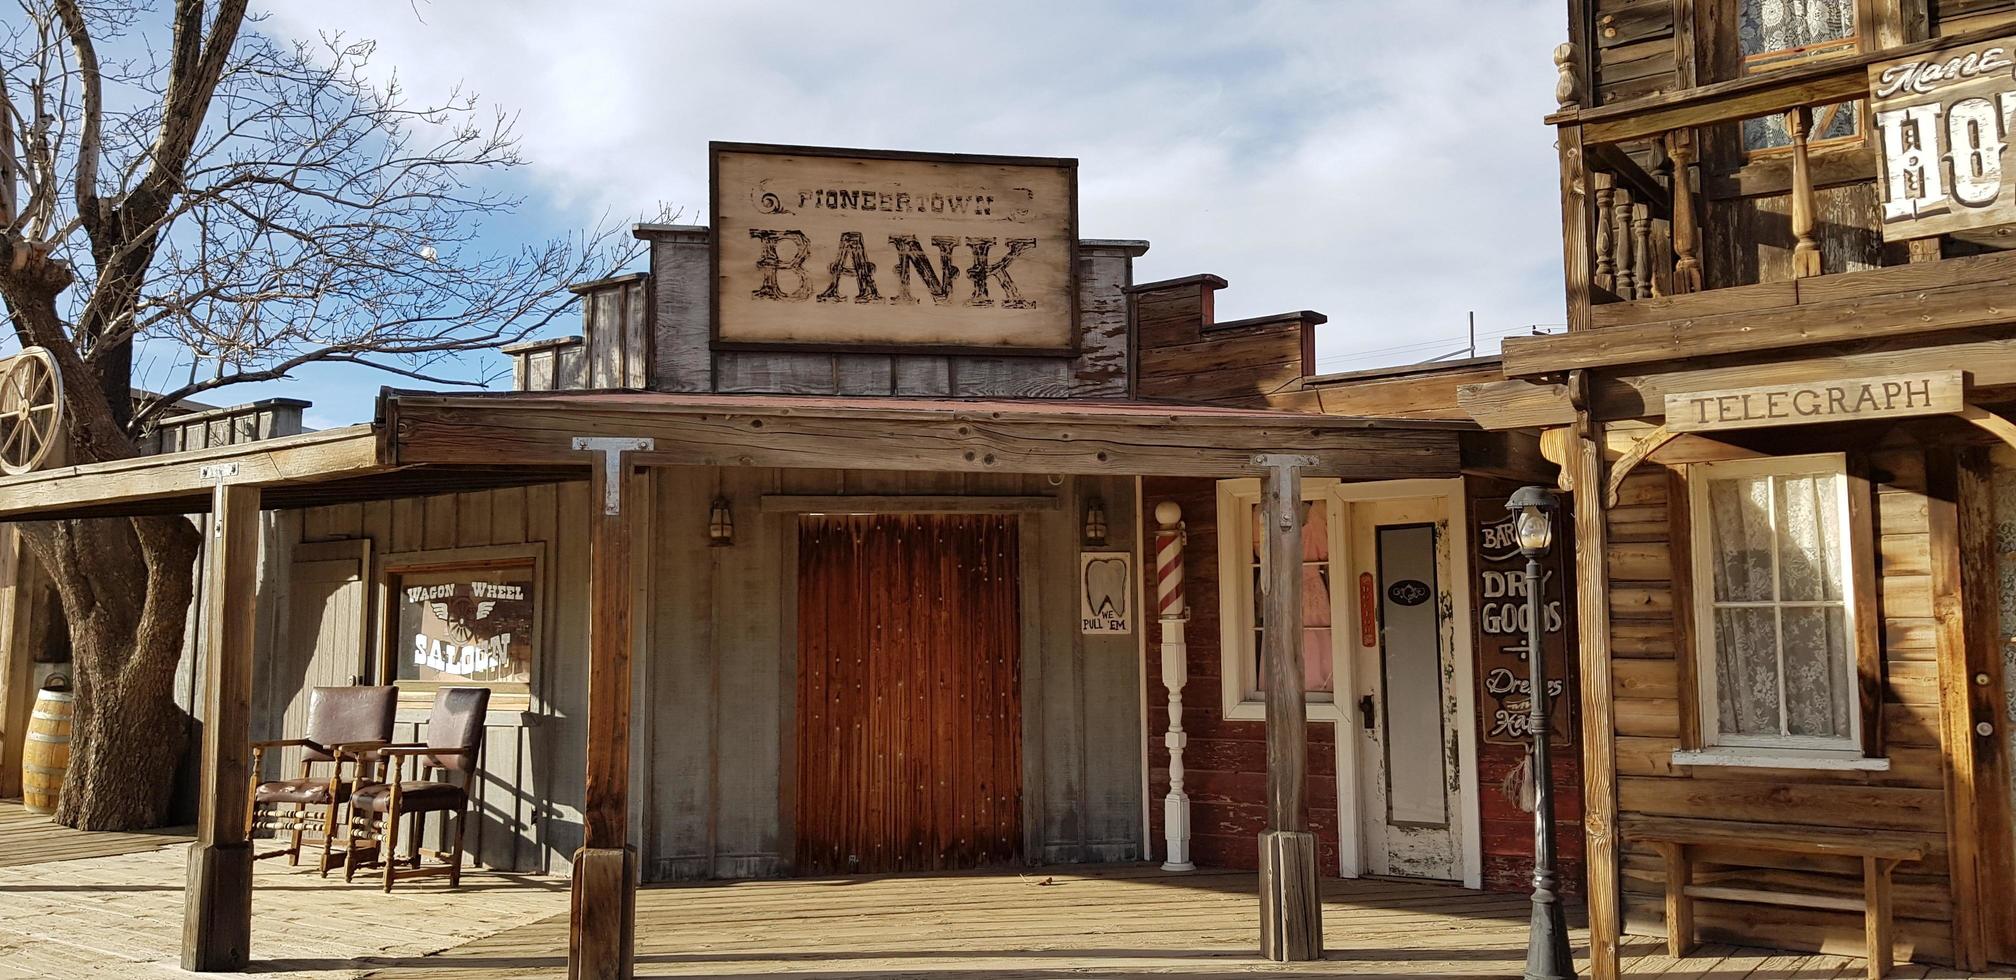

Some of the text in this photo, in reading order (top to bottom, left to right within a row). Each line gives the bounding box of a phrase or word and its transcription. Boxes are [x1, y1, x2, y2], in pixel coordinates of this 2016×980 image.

[1875, 91, 2016, 221] HO
[798, 188, 994, 215] PIONEERTOWN
[749, 229, 1037, 309] BANK
[1690, 379, 1932, 424] TELEGRAPH
[407, 581, 524, 603] WAGON WHEEL
[1083, 618, 1103, 630] PULL
[1101, 610, 1114, 619] WE
[414, 632, 511, 675] SALOON
